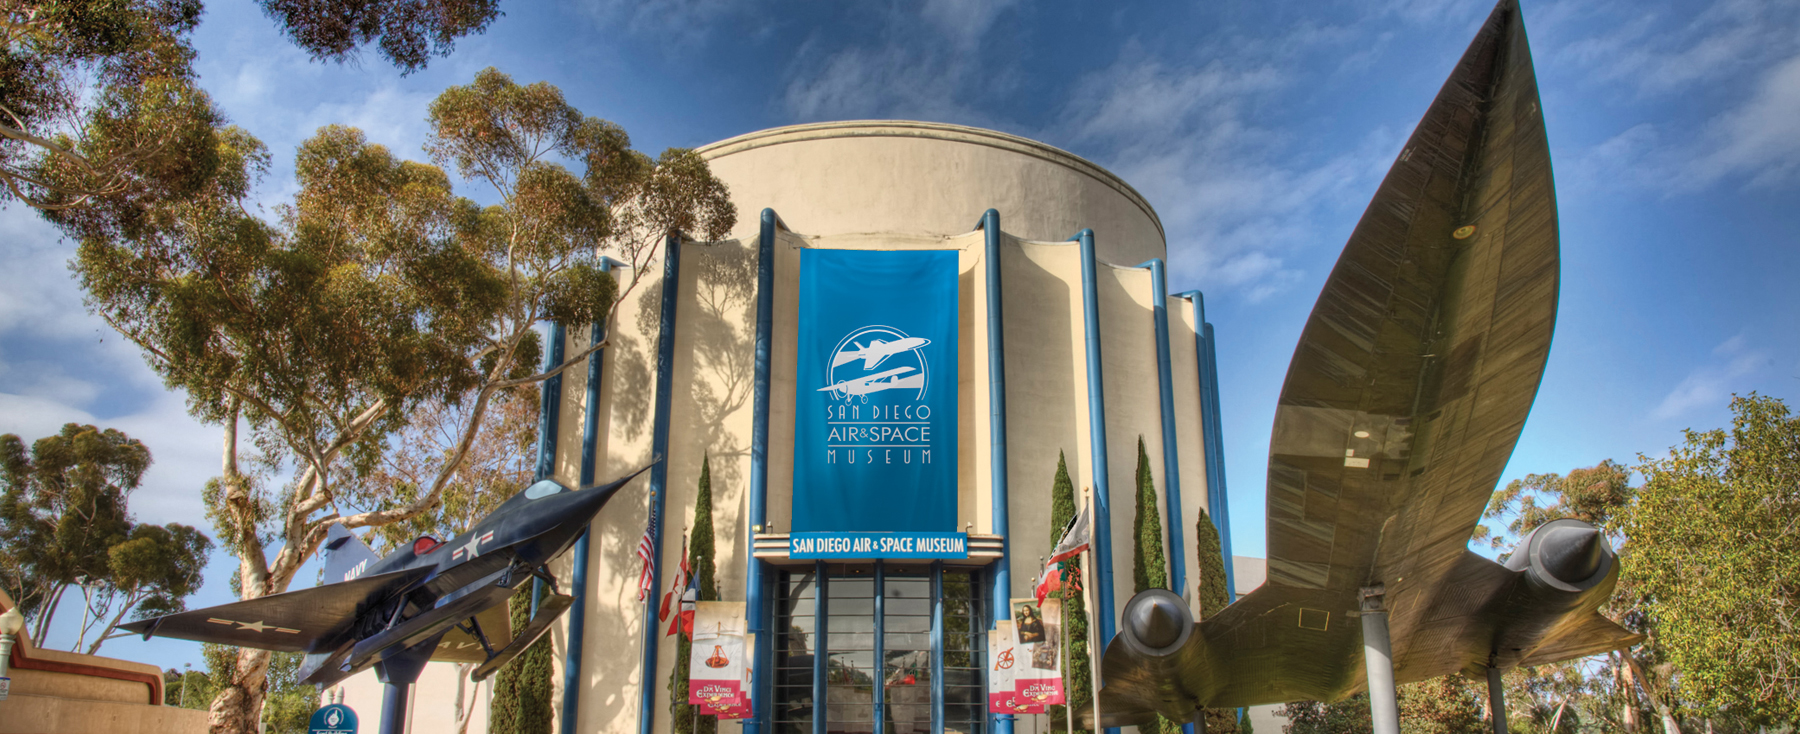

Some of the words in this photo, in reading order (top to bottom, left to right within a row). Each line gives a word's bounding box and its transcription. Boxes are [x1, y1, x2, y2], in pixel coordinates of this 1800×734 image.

[828, 405, 859, 420] SAN
[873, 405, 931, 420] DIEGO
[828, 449, 931, 464] MUSEUM
[792, 538, 814, 553] SAN
[816, 537, 851, 553] DIEGO
[853, 537, 872, 552] AIR
[872, 540, 879, 550] &
[880, 537, 913, 552] SPACE
[916, 537, 964, 553] MUSEUM
[344, 558, 368, 582] NAVY
